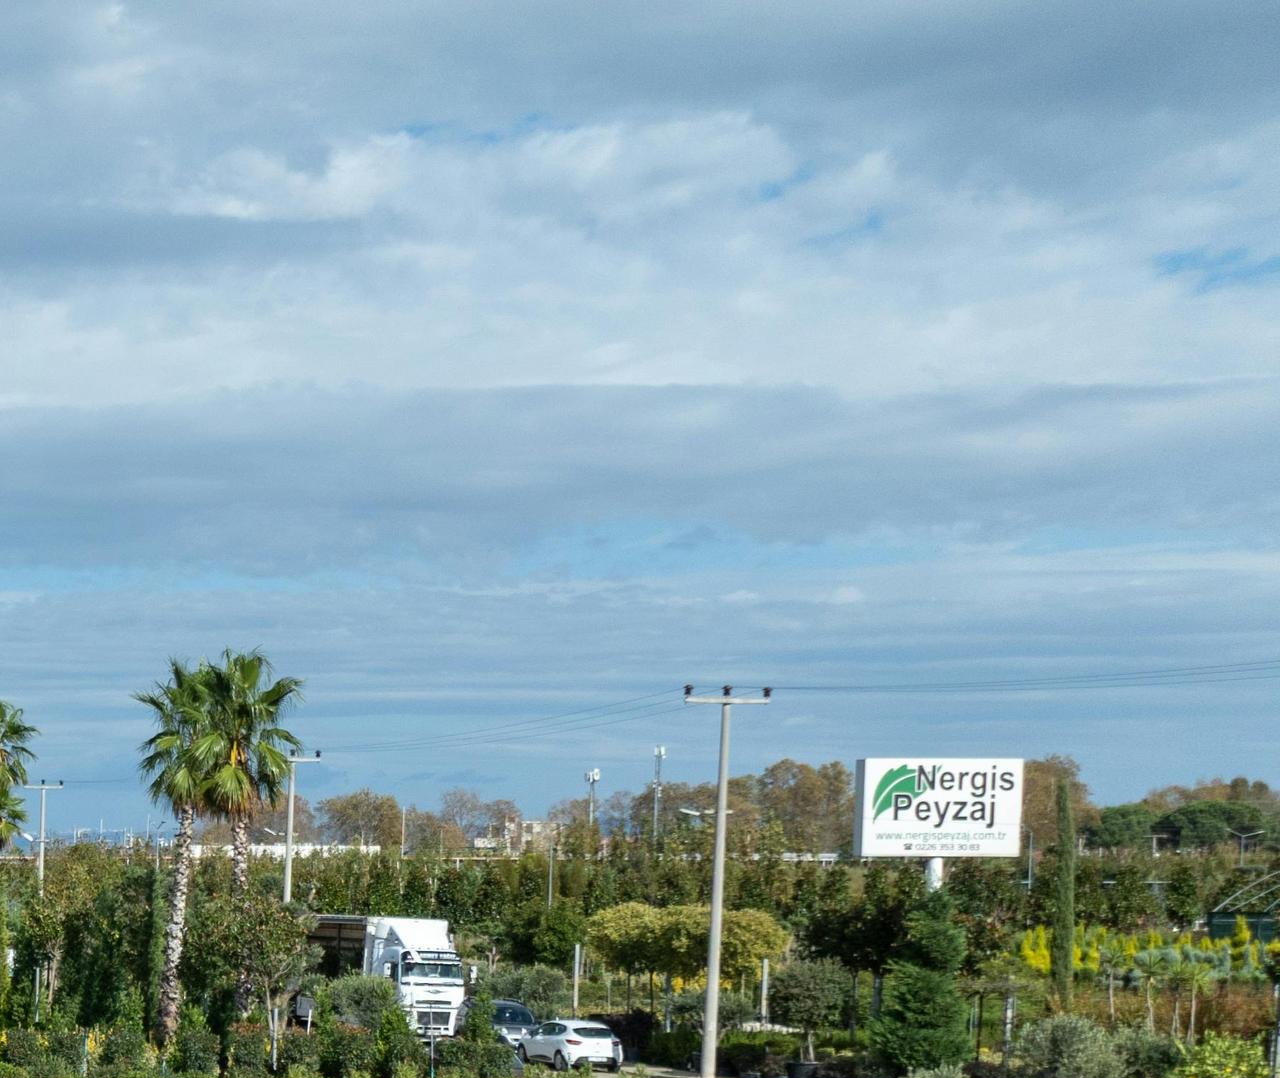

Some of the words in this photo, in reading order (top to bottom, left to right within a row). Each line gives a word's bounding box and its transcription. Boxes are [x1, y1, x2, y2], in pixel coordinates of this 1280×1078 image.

[916, 764, 1015, 798] Nergis
[893, 794, 996, 829] Peyzaj
[875, 831, 1007, 842] www.nergispeyzaj.com.tr
[915, 843, 937, 851] 0226
